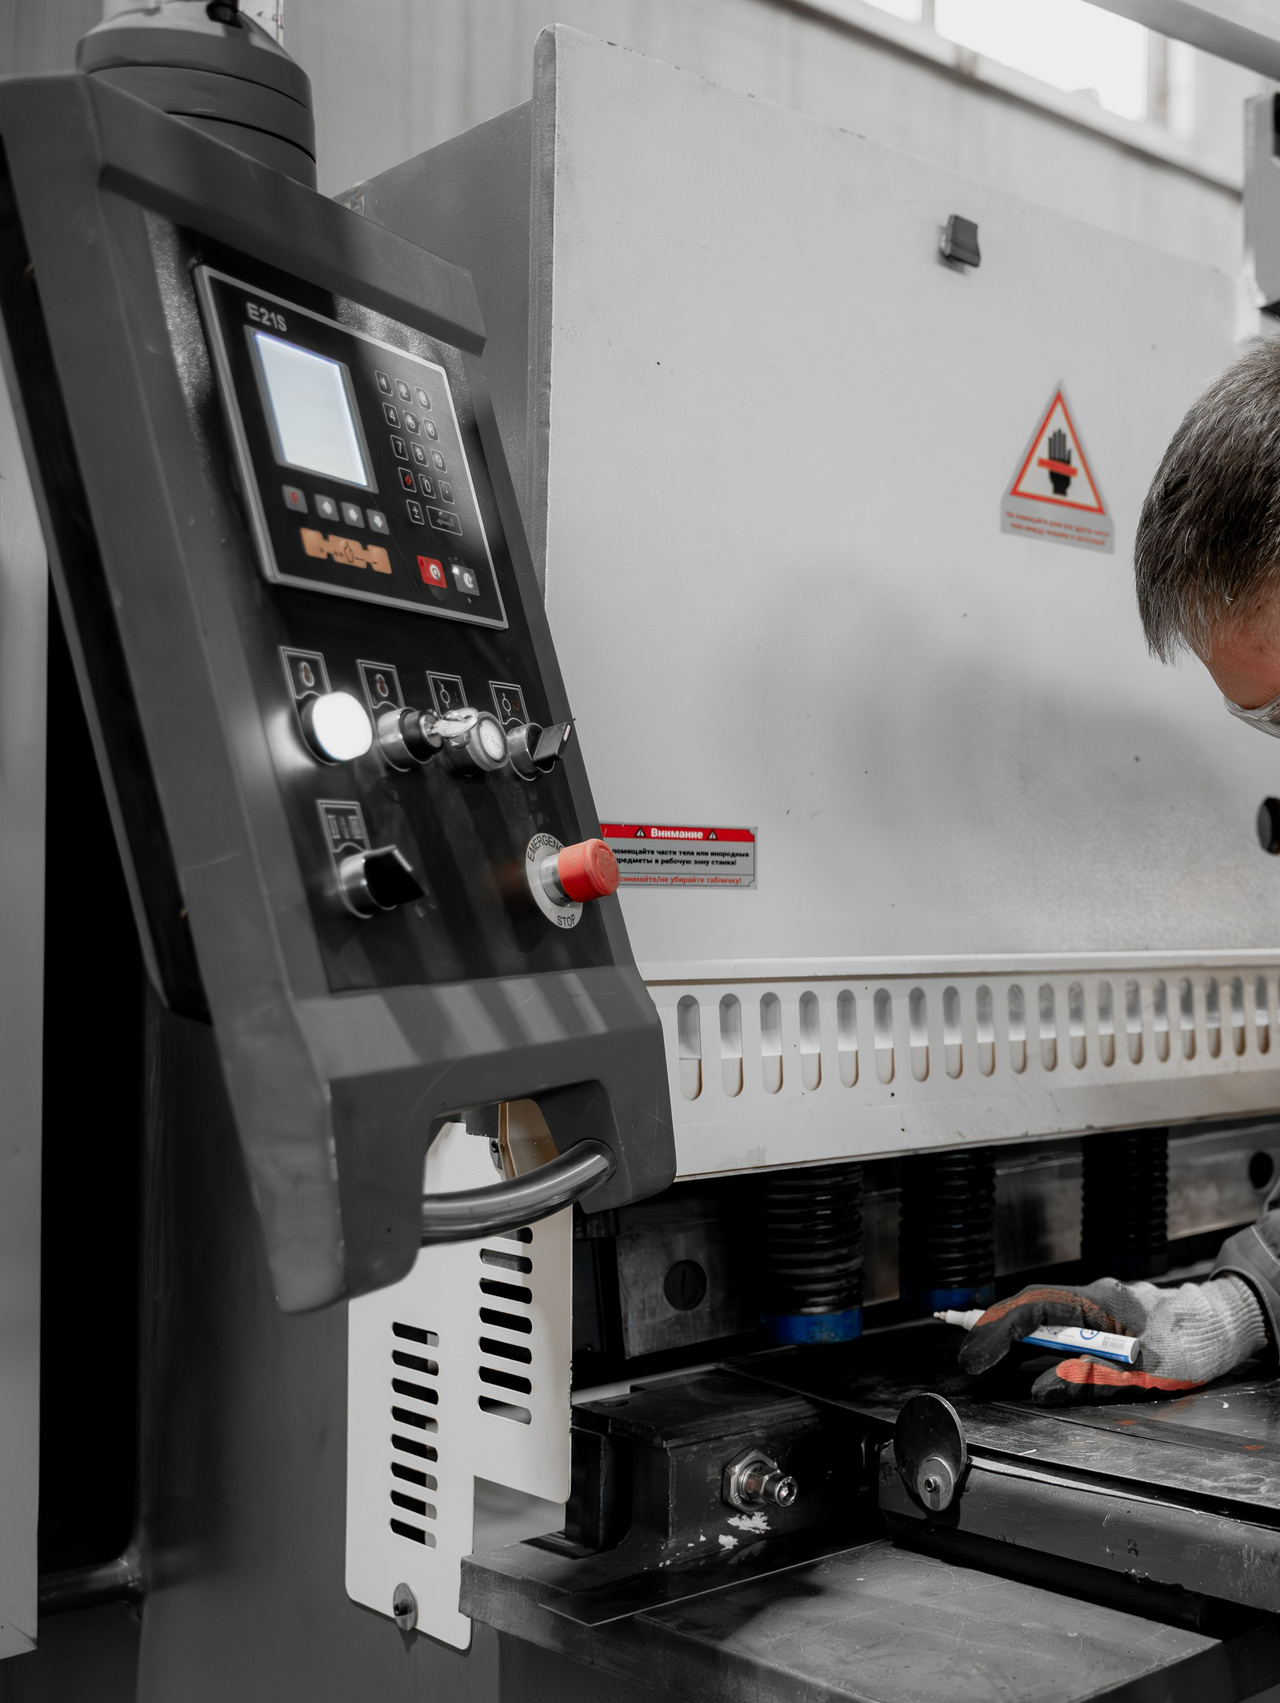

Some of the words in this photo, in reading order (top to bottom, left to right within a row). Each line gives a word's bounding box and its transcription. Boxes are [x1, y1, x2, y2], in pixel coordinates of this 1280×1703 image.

[245, 301, 288, 332] E21S
[650, 827, 704, 840] Внимание
[527, 835, 564, 862] EMERGENC
[710, 851, 750, 859] инородные
[660, 857, 692, 866] рабочую
[670, 876, 705, 885] убирайте
[706, 876, 742, 886] табличку!
[557, 914, 576, 927] STOP
